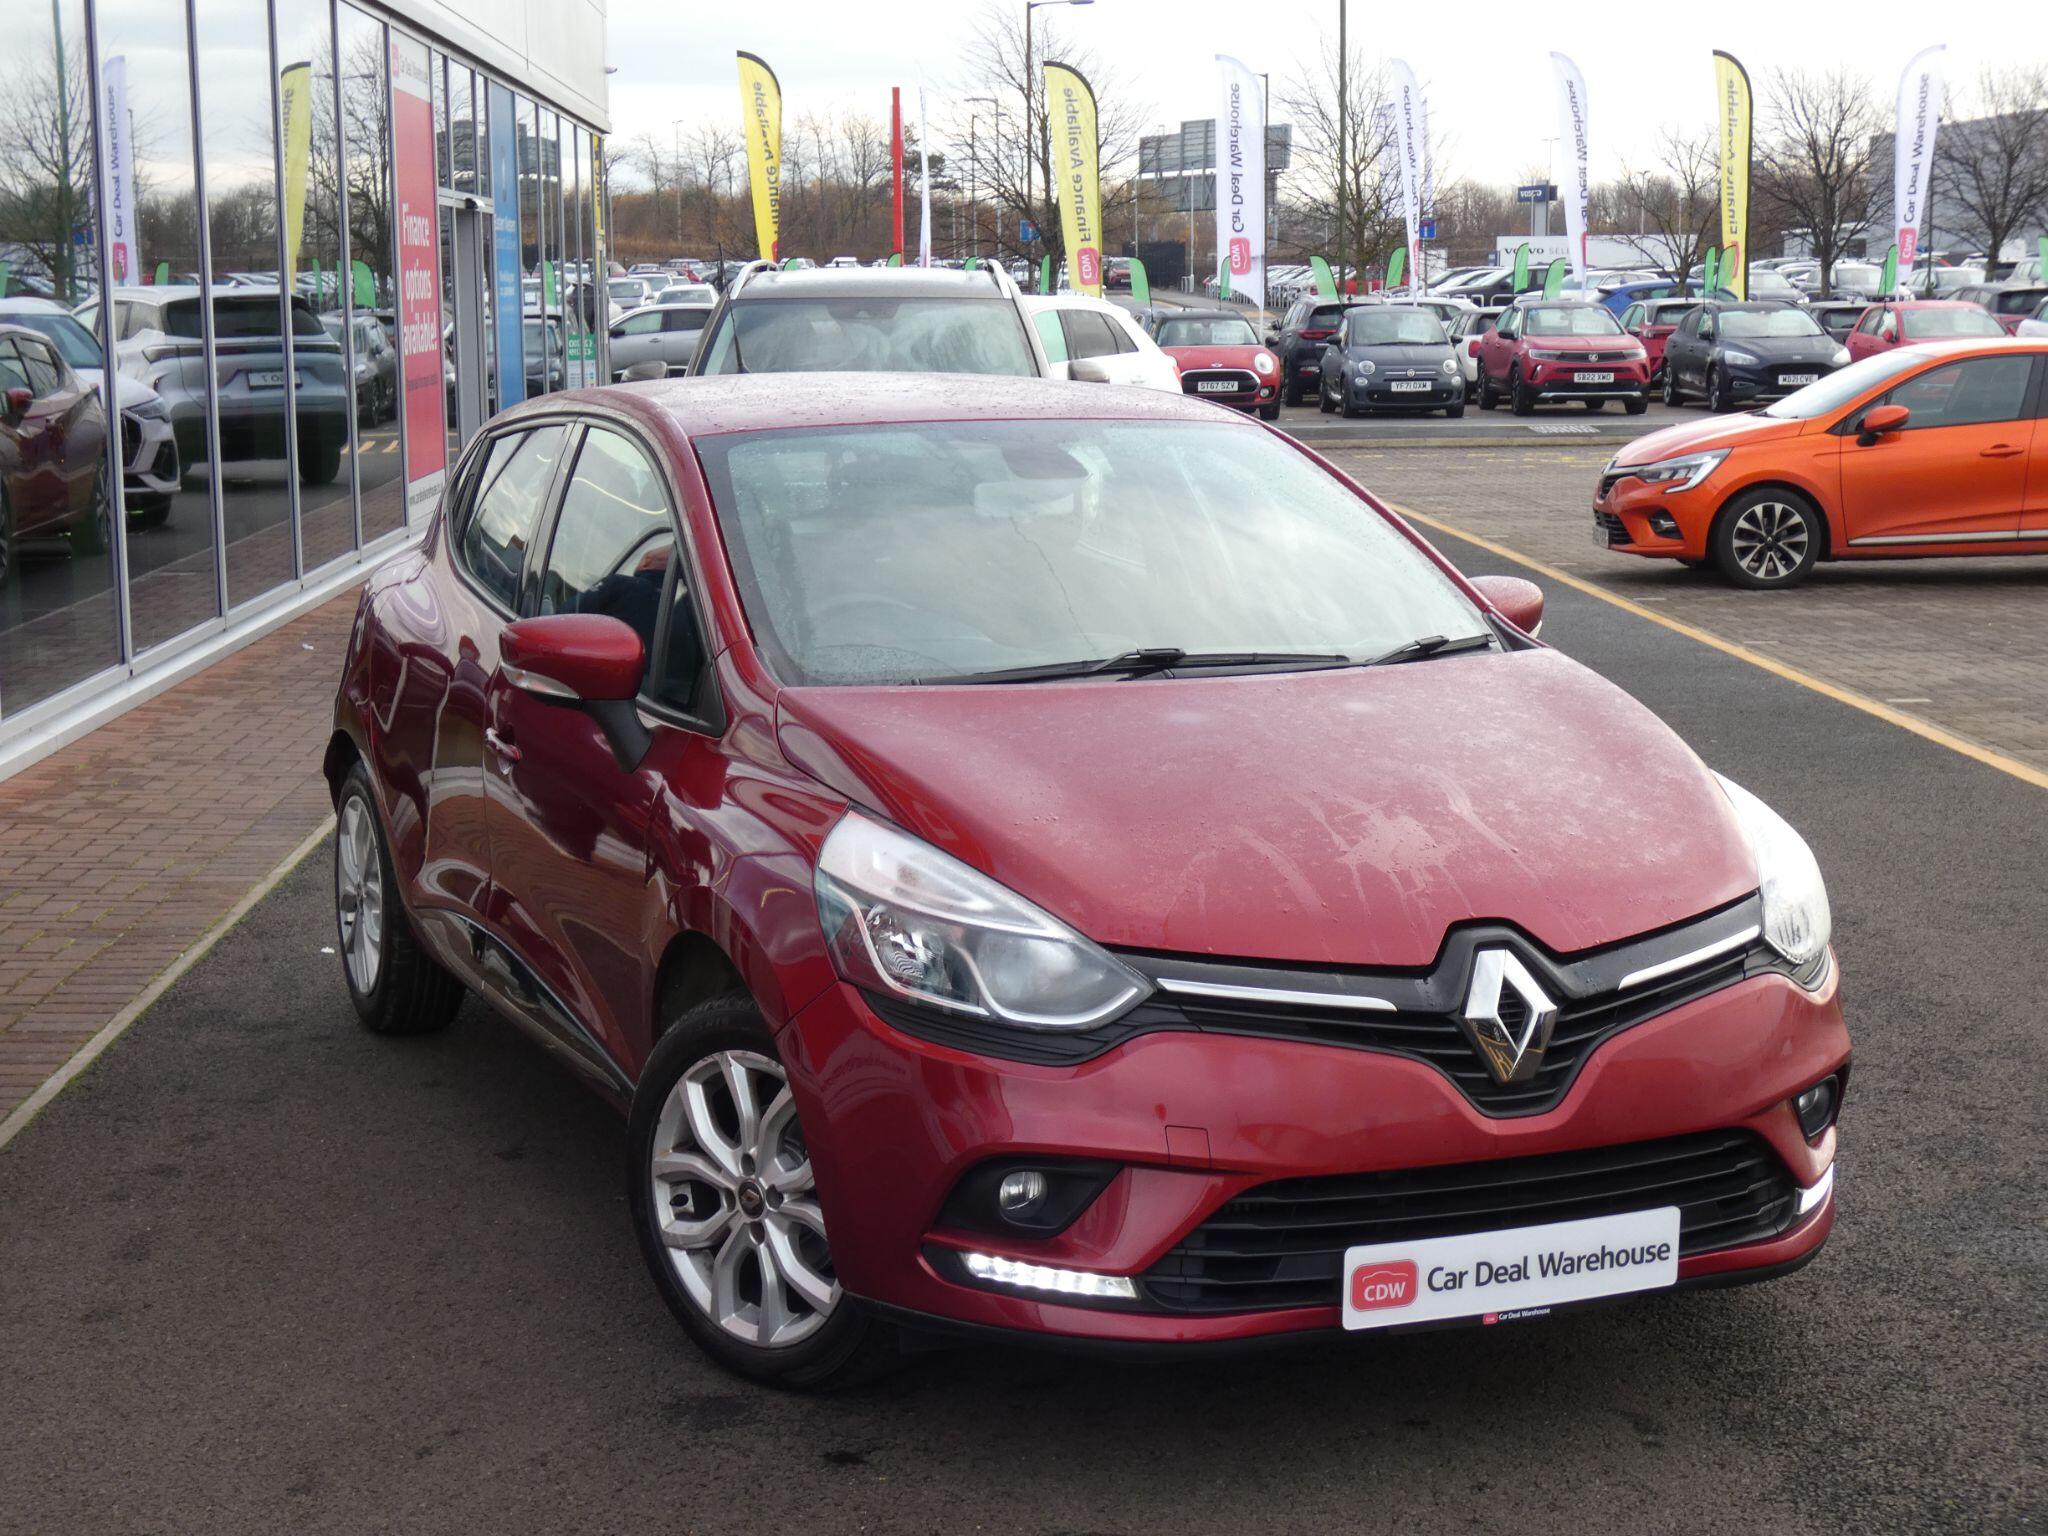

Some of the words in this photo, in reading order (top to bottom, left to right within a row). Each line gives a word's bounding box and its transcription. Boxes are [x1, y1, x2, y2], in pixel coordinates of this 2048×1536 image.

[106, 84, 120, 171] Warehouse
[1912, 73, 1929, 160] Warehouse
[112, 175, 121, 206] Deal
[1907, 163, 1920, 196] Deal
[113, 210, 123, 238] Car
[402, 203, 430, 247] Finance
[1904, 199, 1916, 224] Car
[1504, 247, 1545, 255] VOVO
[405, 258, 432, 313] options
[403, 311, 438, 356] available!
[1363, 1281, 1406, 1302] CDW
[1427, 1266, 1469, 1292] Car
[1475, 1256, 1530, 1288] Deal
[1538, 1242, 1671, 1279] Warehouse
